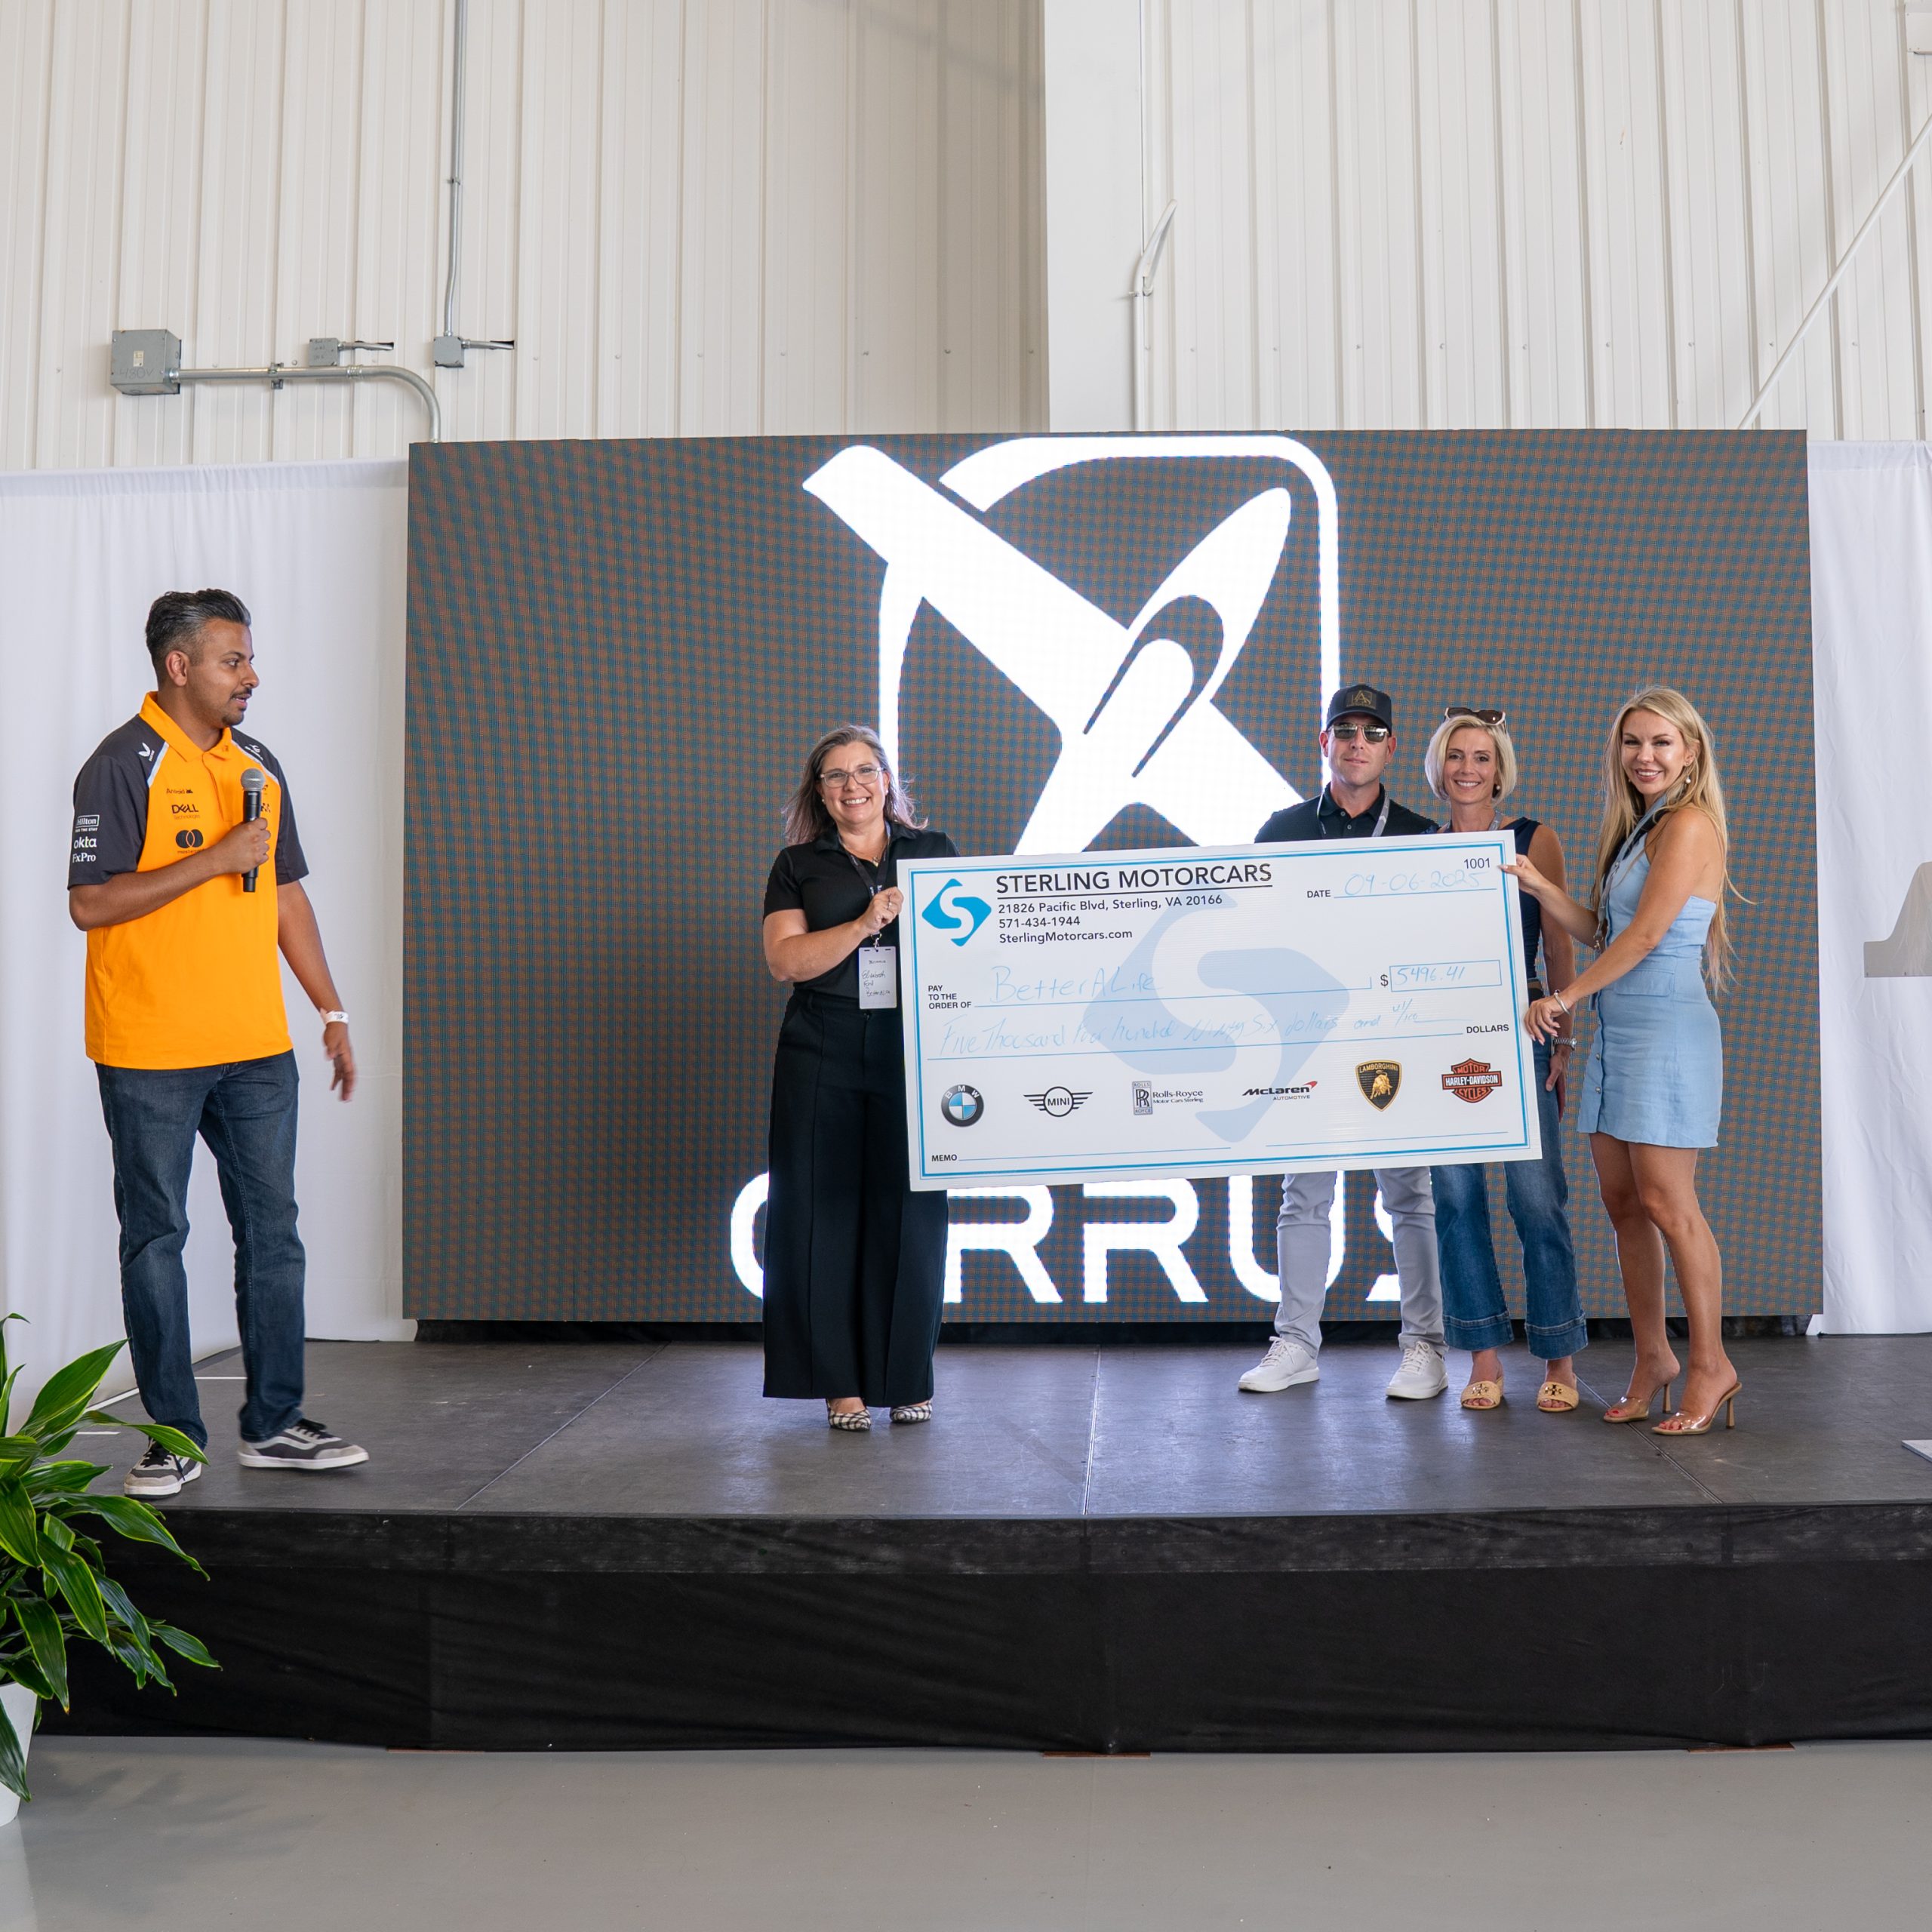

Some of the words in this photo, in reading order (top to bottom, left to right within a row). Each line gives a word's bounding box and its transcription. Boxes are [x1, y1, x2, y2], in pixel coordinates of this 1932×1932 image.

[171, 804, 198, 814] DELL
[77, 817, 97, 826] Hilton
[73, 835, 97, 849] okta
[72, 852, 97, 863] FxPro
[1463, 857, 1491, 869] 1001
[996, 871, 1109, 894] STERLING
[1118, 863, 1272, 888] MOTORCARS
[1306, 889, 1331, 899] DATE
[998, 903, 1035, 914] 21826
[1039, 900, 1076, 912] Pacific
[1079, 899, 1109, 911] Blvd,
[1112, 897, 1161, 910] Sterling,
[1165, 896, 1183, 906] VA
[1186, 894, 1223, 906] 20166
[998, 915, 1081, 928] 571-434-1944
[999, 930, 1133, 945] SterlingMotorcars.com
[1380, 974, 1389, 987] $
[1395, 965, 1466, 985] 5496.41
[928, 984, 943, 992] PAY
[940, 992, 958, 1001] THE
[928, 1001, 958, 1010] ORDER
[960, 1001, 972, 1009] OF
[1466, 1023, 1509, 1035] DOLLARS
[939, 1014, 980, 1057] Five
[1353, 1014, 1381, 1030] and
[1358, 1062, 1398, 1073] LAMBORGHINI
[1457, 1063, 1486, 1073] MOTOR
[1445, 1074, 1499, 1086] HARLEY-DAVIDSON
[944, 1085, 980, 1099] BMW
[1152, 1090, 1204, 1099] Rolls-Royce
[1242, 1086, 1310, 1097] McLaren
[1458, 1087, 1487, 1100] CYCLES
[1047, 1097, 1070, 1106] MINI
